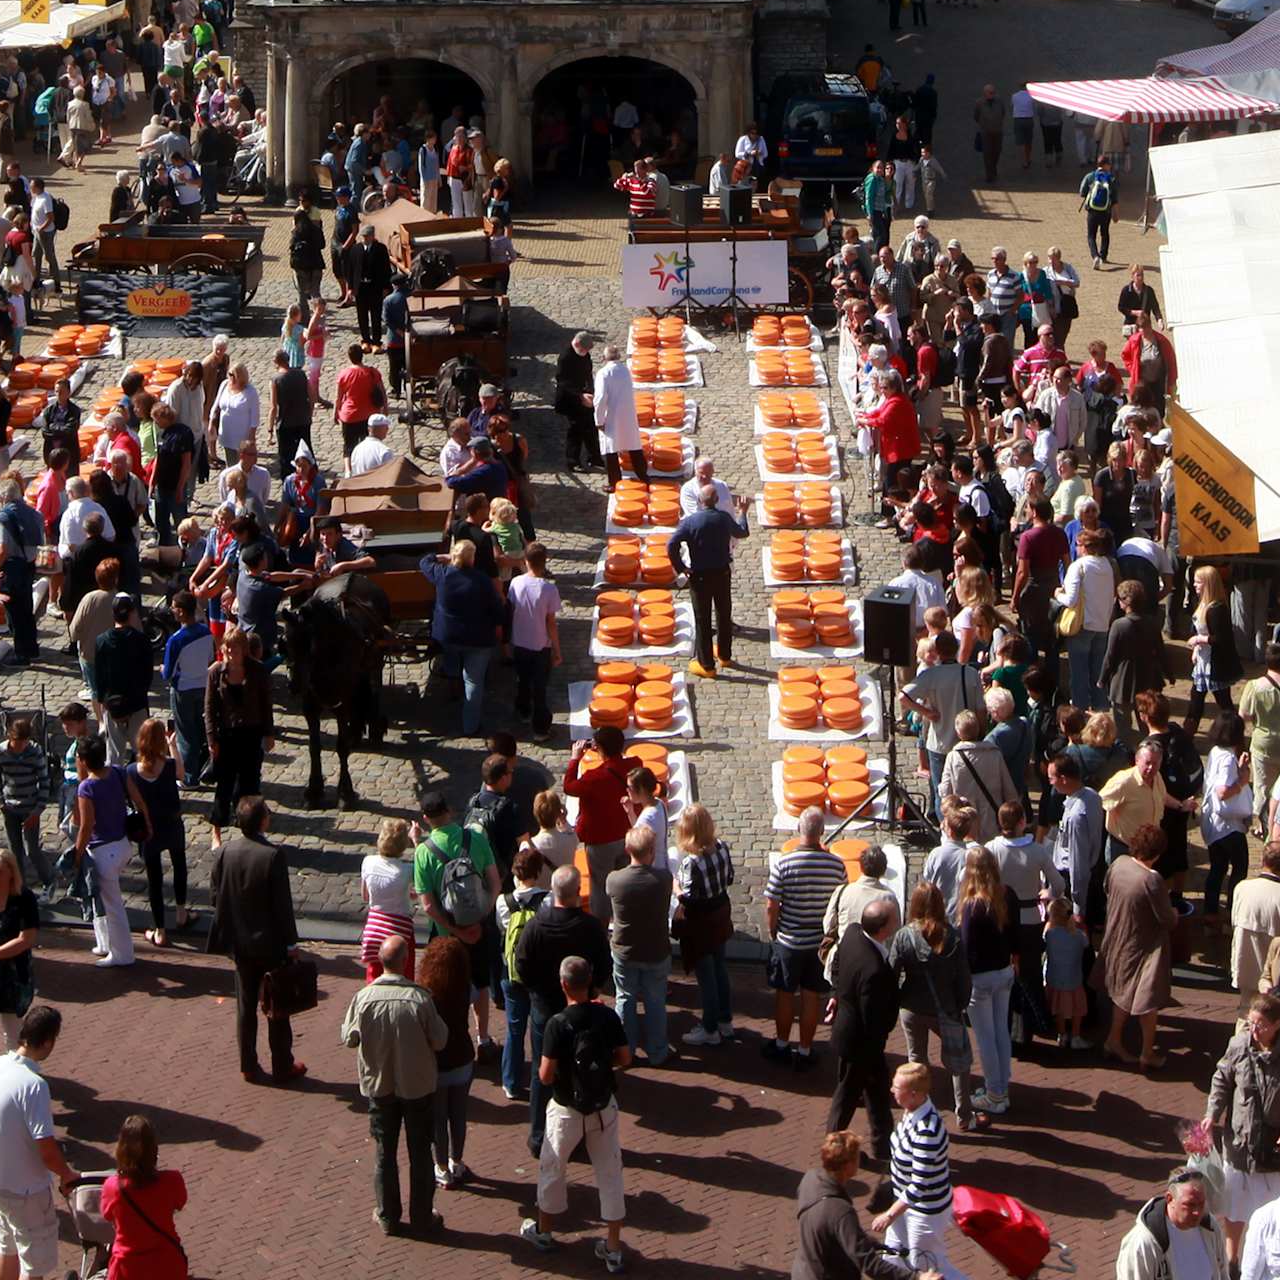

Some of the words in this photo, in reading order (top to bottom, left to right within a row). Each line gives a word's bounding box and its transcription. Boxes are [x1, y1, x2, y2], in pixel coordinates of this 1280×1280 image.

[672, 286, 750, 296] FrielandCamina
[132, 295, 189, 308] VERGEER
[1190, 501, 1232, 543] KAAS
